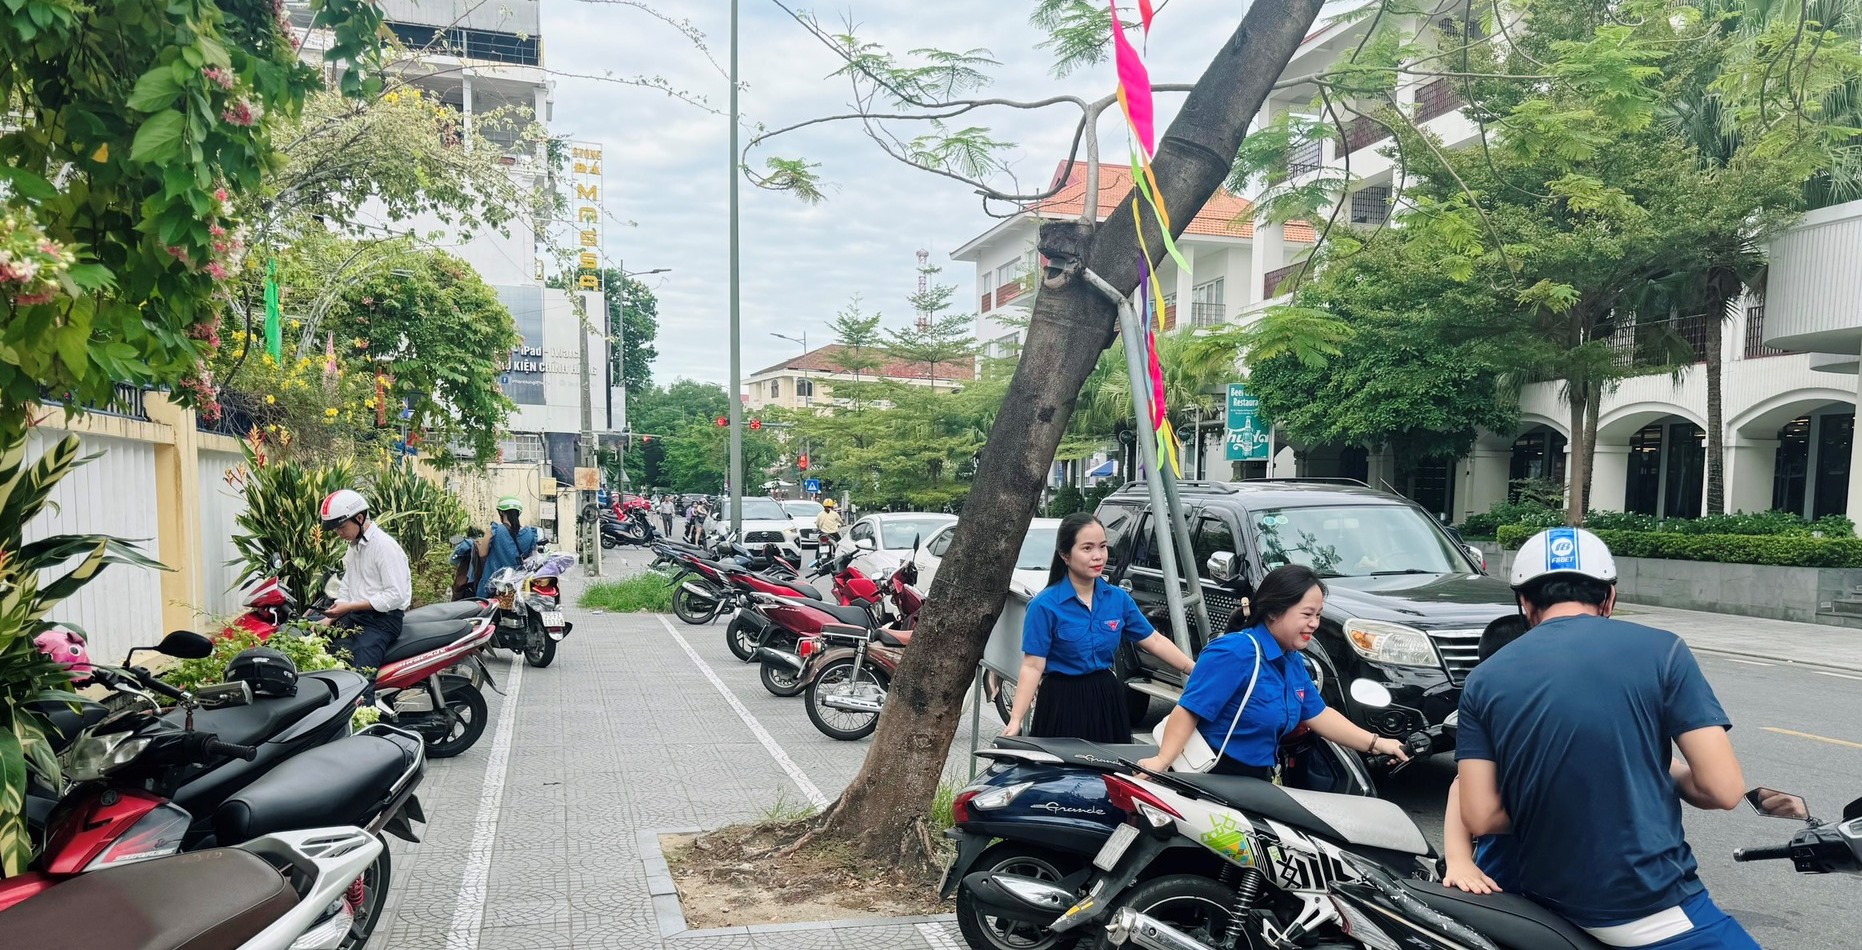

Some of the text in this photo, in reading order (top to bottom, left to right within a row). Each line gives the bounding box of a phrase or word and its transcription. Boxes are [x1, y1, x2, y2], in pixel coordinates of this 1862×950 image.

[521, 345, 542, 358] iPad
[514, 358, 537, 374] KIỆN
[1038, 801, 1106, 815] Grande
